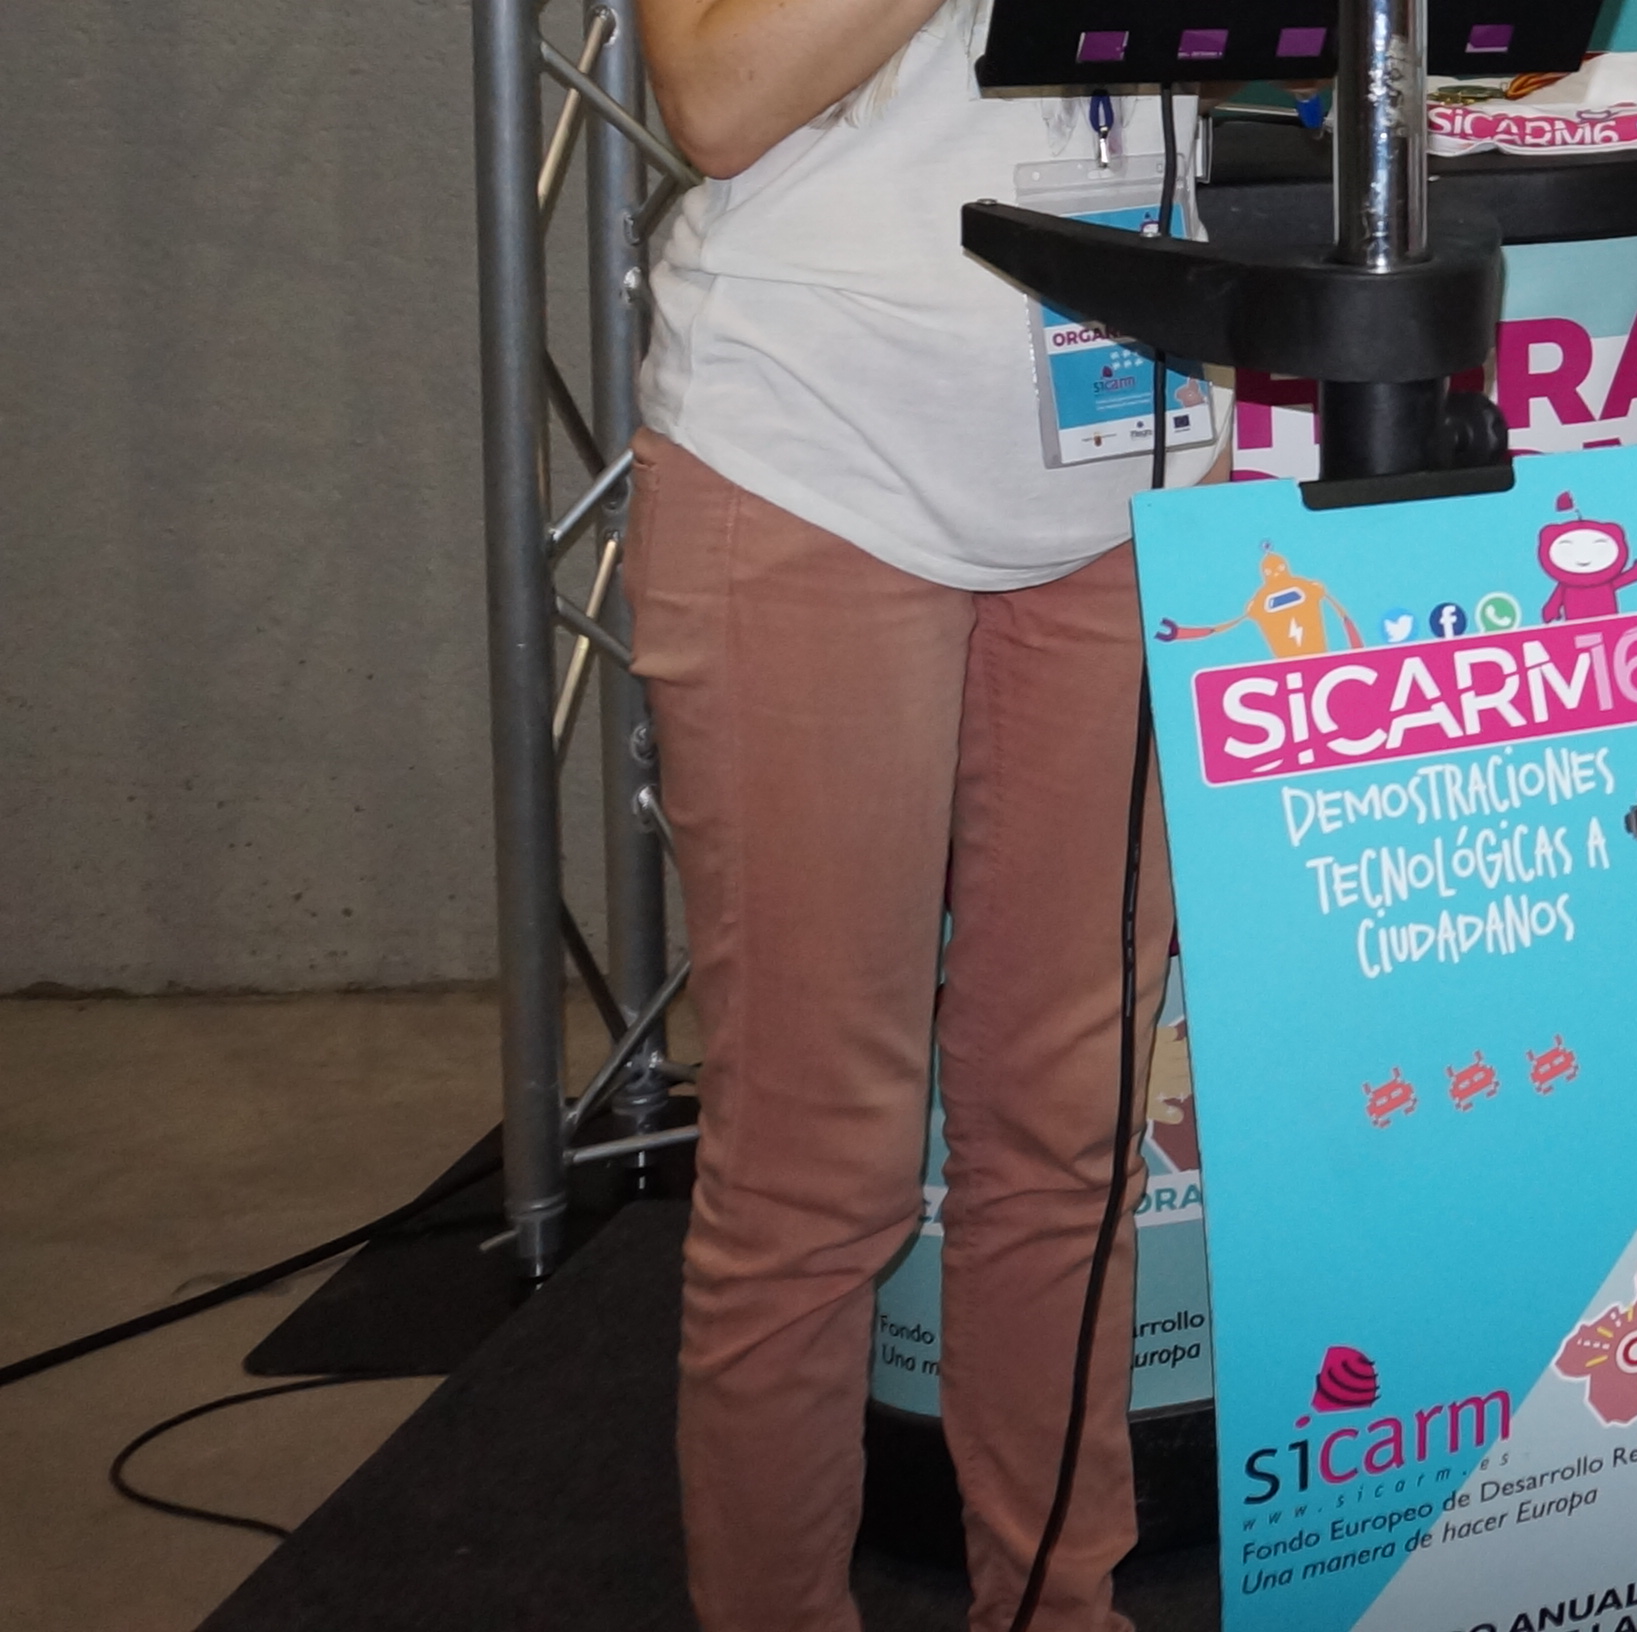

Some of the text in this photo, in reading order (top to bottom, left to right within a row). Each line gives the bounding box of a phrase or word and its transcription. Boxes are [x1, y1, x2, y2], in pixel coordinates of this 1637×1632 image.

[1586, 816, 1611, 869] A
[1243, 1388, 1512, 1506] sicarm
[1241, 1485, 1599, 1596] Una manera de hacer Europa
[1242, 1530, 1321, 1564] Fondo
[1329, 1501, 1434, 1544] Europeo
[1441, 1489, 1471, 1512] de
[1480, 1455, 1603, 1503] Desarrollo
